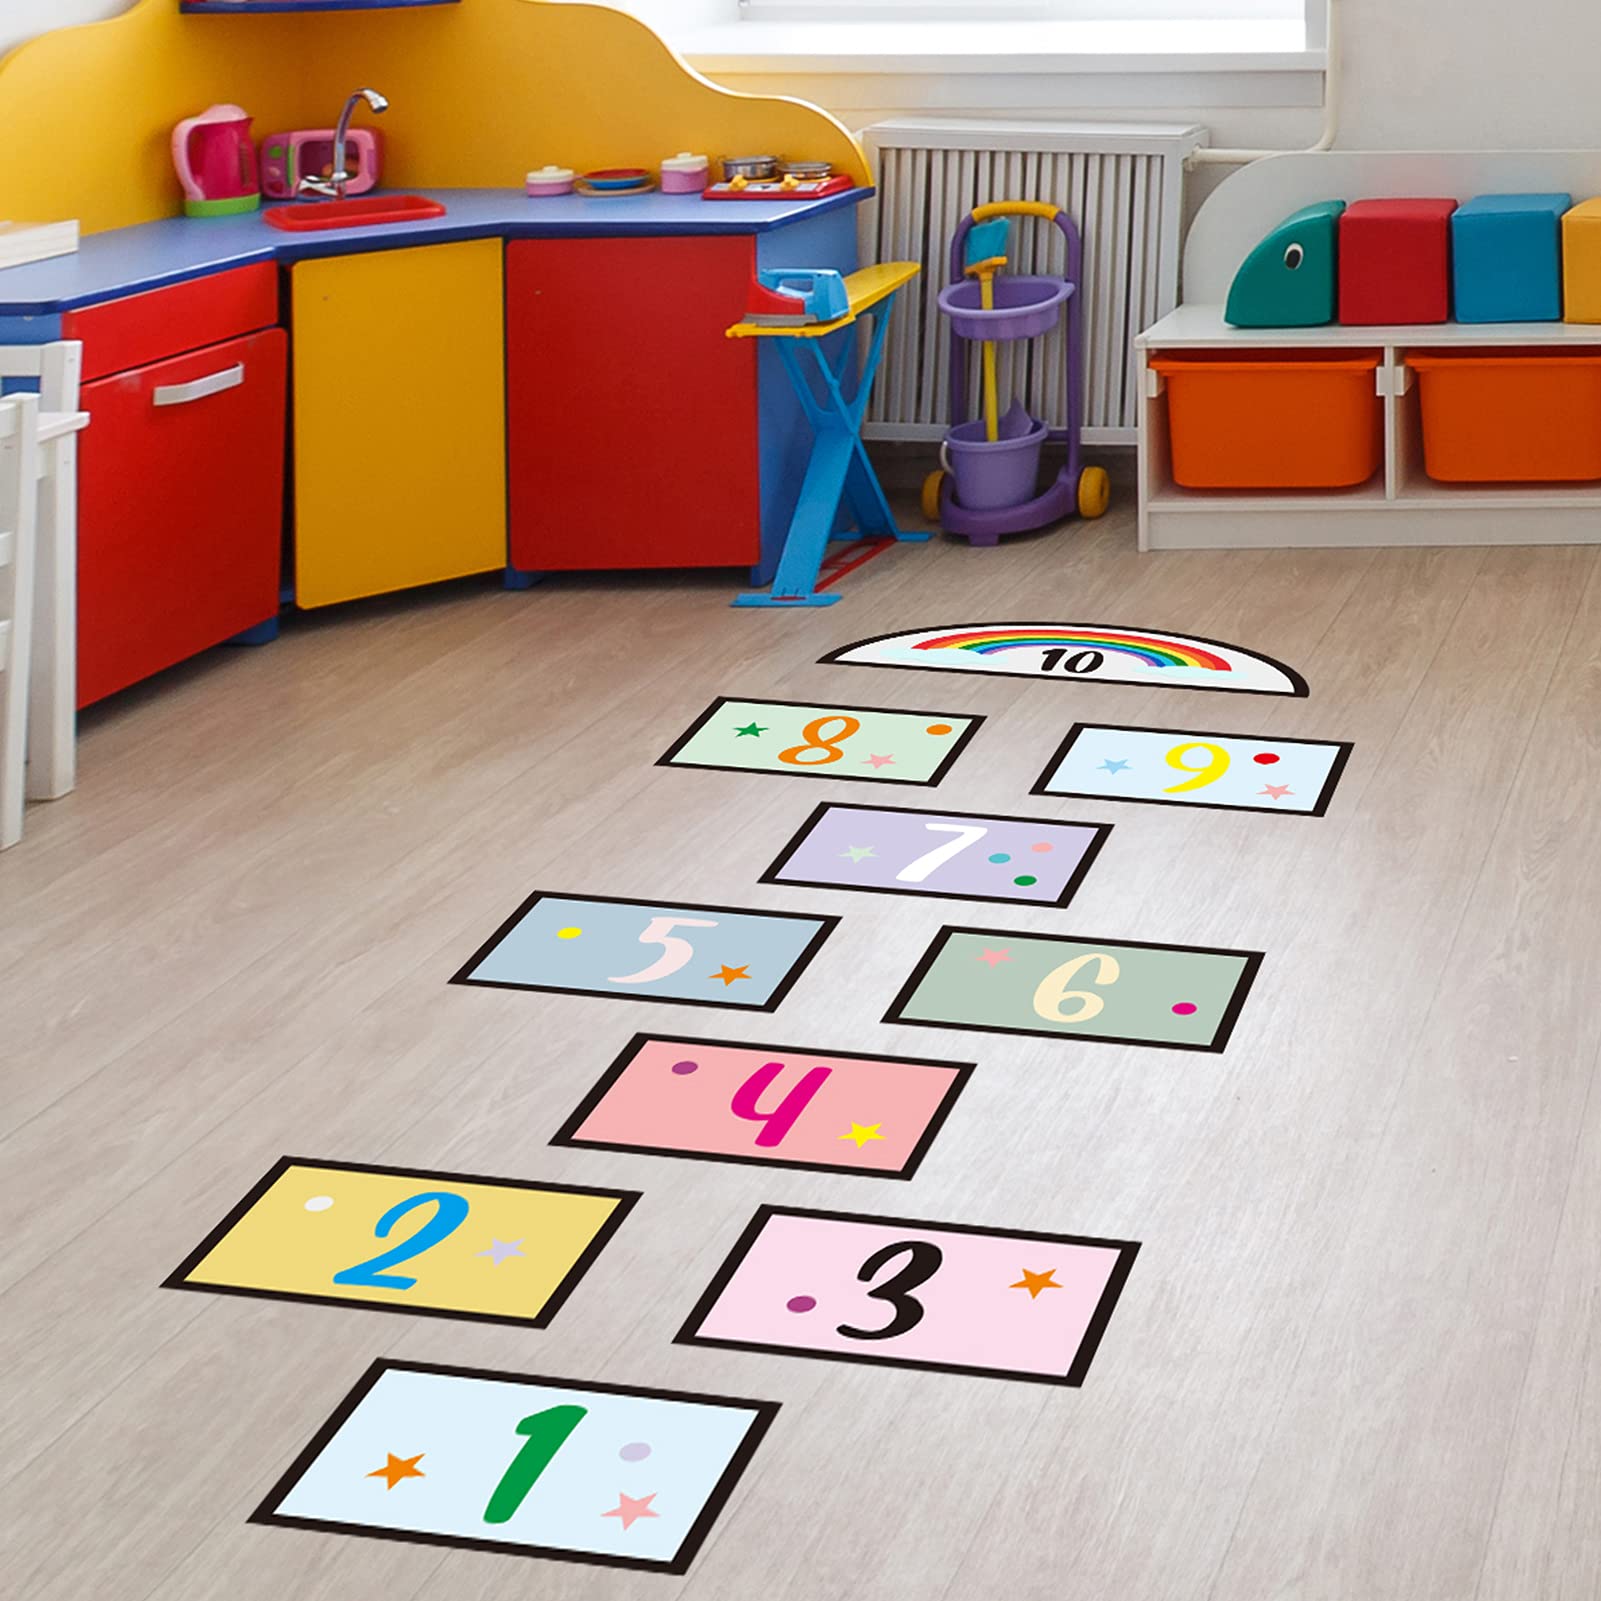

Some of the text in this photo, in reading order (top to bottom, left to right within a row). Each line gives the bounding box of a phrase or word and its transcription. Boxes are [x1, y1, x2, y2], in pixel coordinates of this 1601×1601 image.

[1040, 647, 1104, 674] 10
[777, 716, 860, 766] 8
[1162, 742, 1231, 794] 9
[895, 823, 988, 883] 7
[608, 917, 719, 984] 5
[1033, 953, 1120, 1023] 6
[731, 1062, 832, 1148] 4
[333, 1191, 470, 1291] 2
[836, 1240, 943, 1341] 3
[483, 1404, 588, 1524] 1
